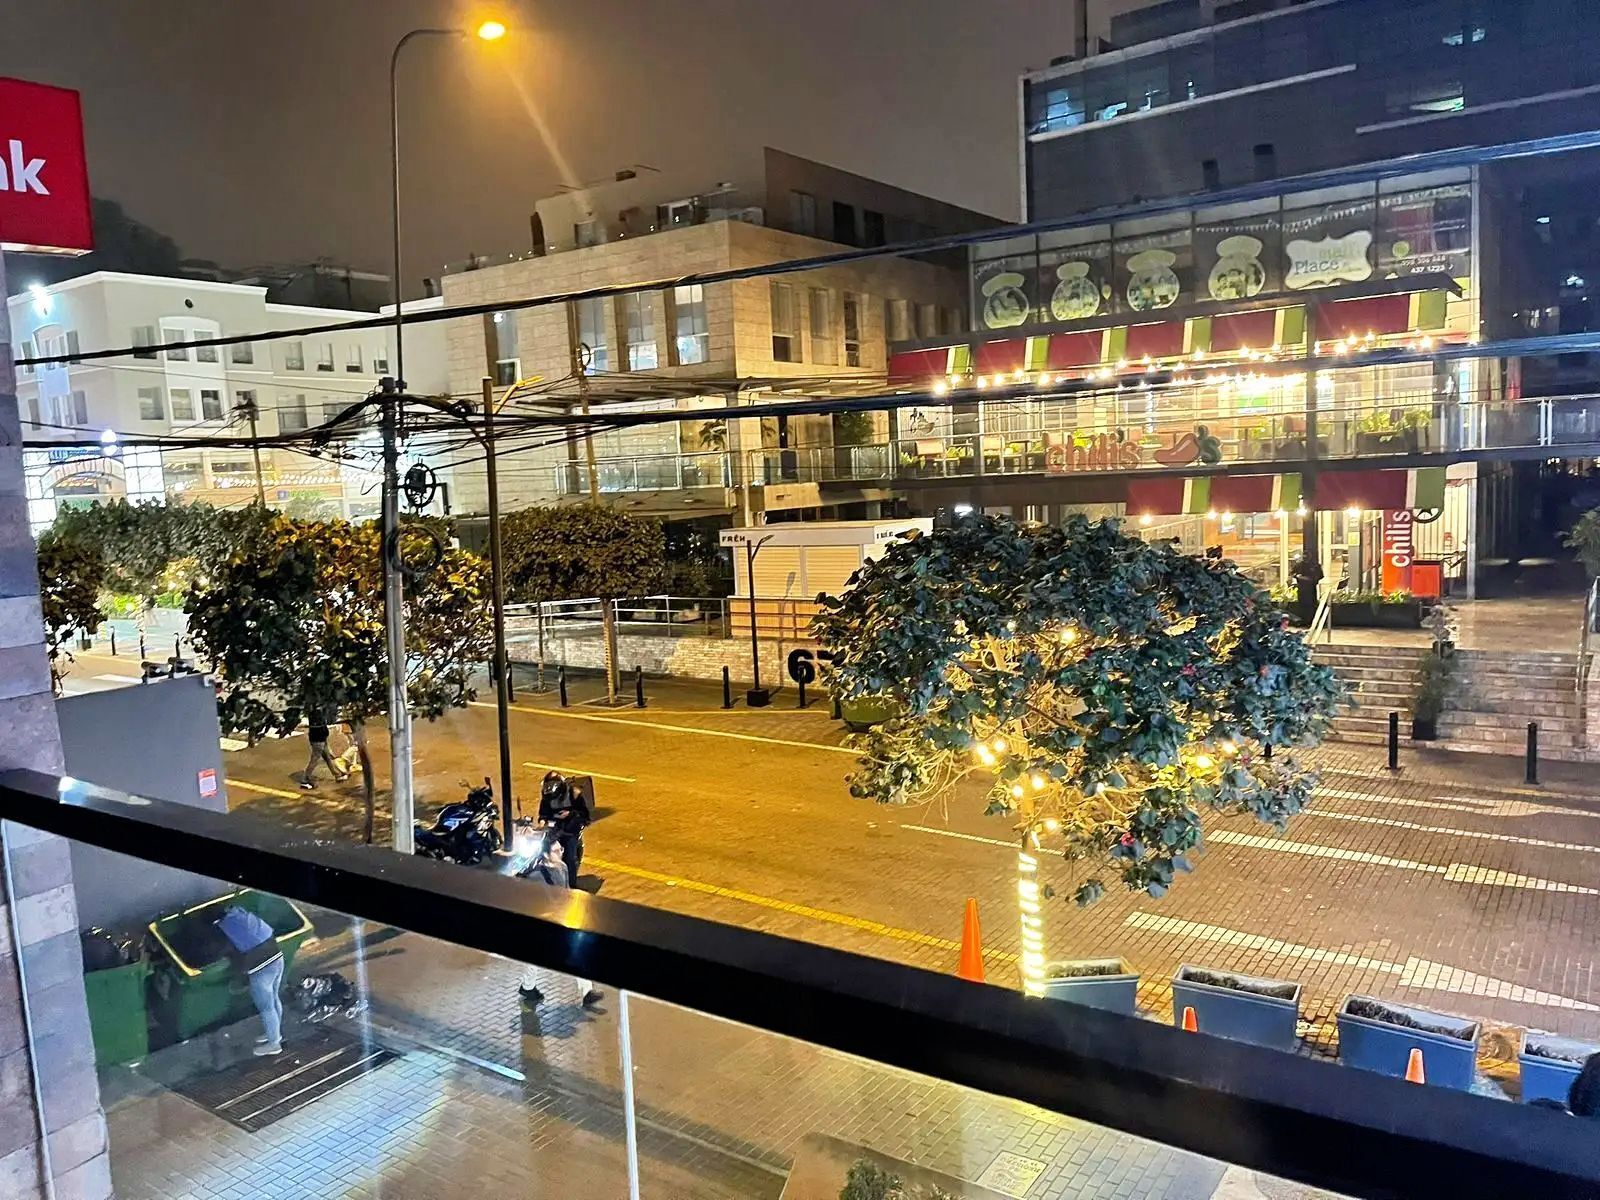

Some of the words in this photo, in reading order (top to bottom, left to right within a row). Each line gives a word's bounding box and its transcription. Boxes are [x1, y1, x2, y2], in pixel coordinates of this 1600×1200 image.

[0, 139, 50, 195] k
[1294, 259, 1340, 275] Place
[1384, 510, 1411, 567] chilis
